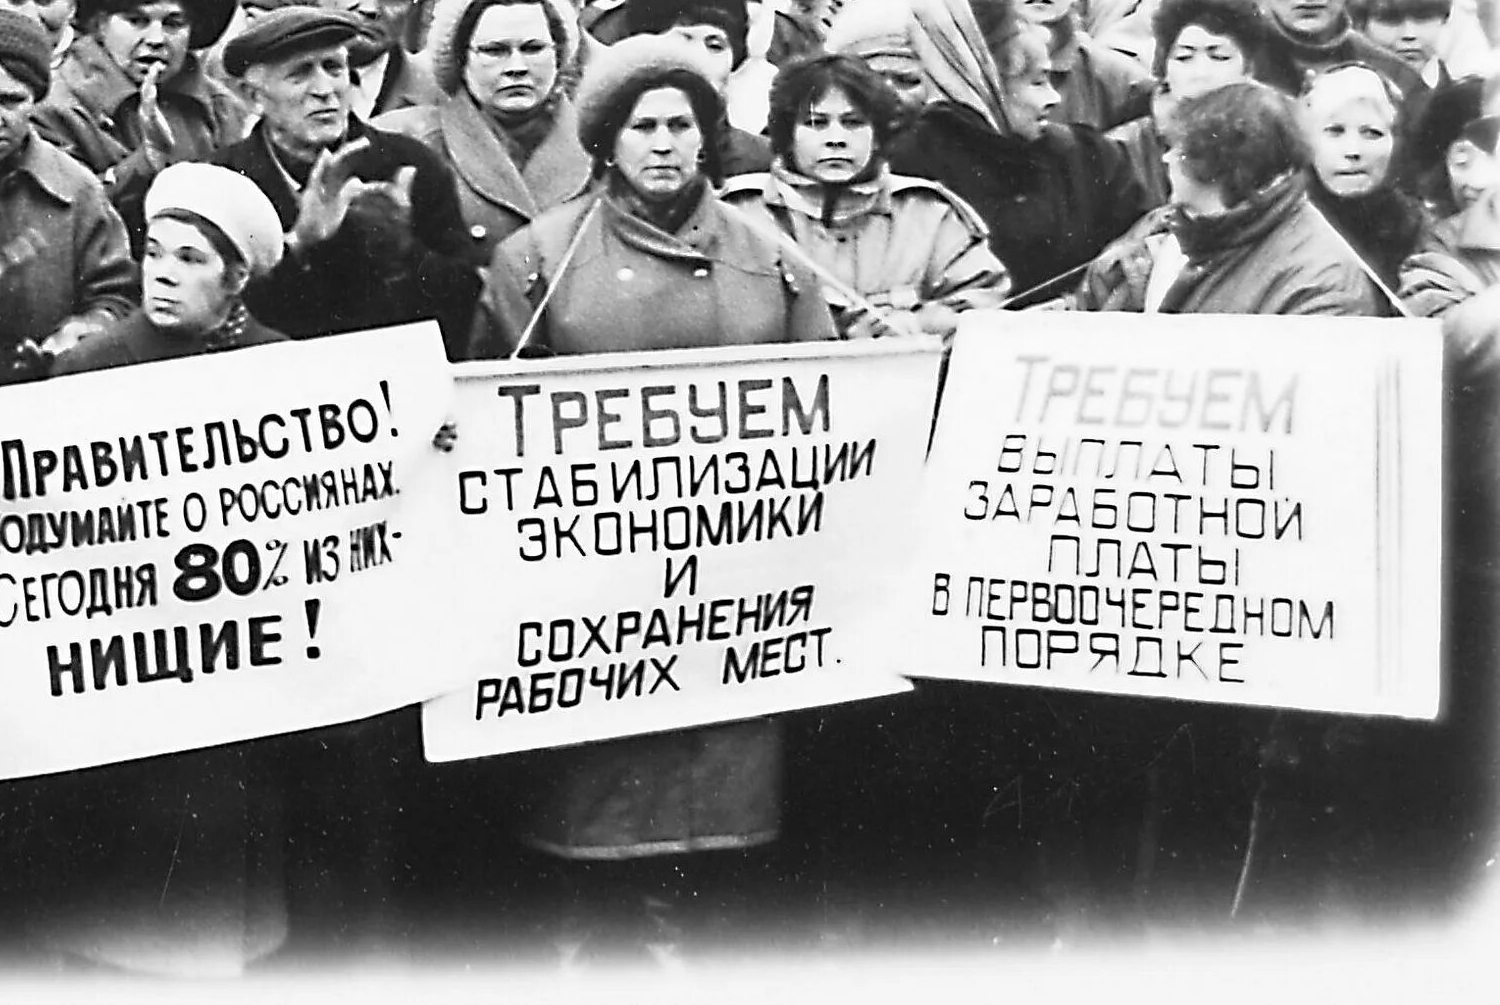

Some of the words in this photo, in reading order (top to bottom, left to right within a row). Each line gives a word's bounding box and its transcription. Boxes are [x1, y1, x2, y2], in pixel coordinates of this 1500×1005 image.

[498, 374, 830, 457] ТРЕБУЕМ
[1016, 355, 1297, 436] ТРЕБУЕМ
[459, 439, 876, 514] СТАБИЛИЗАЦИИ
[997, 435, 1274, 490] ВЫПЛАТЫ
[183, 493, 206, 532] О
[518, 490, 823, 561] ЭКОНОМИКИ
[964, 480, 1302, 541] ЗАРАБОТНОЙ
[173, 539, 288, 602] 80%
[304, 535, 339, 584] ИЗ
[664, 555, 697, 598] И
[1048, 534, 1239, 586] ПЛАТЫ
[518, 585, 814, 667] СОХРАНЕНИЯ
[932, 573, 950, 616] В
[966, 576, 1333, 639] ПЕРВООЧЕРЕДНОМ
[476, 655, 680, 720] РАБОЧИХ
[723, 627, 841, 684] МЕСТ.
[981, 625, 1244, 683] ПОРЯДКЕ
